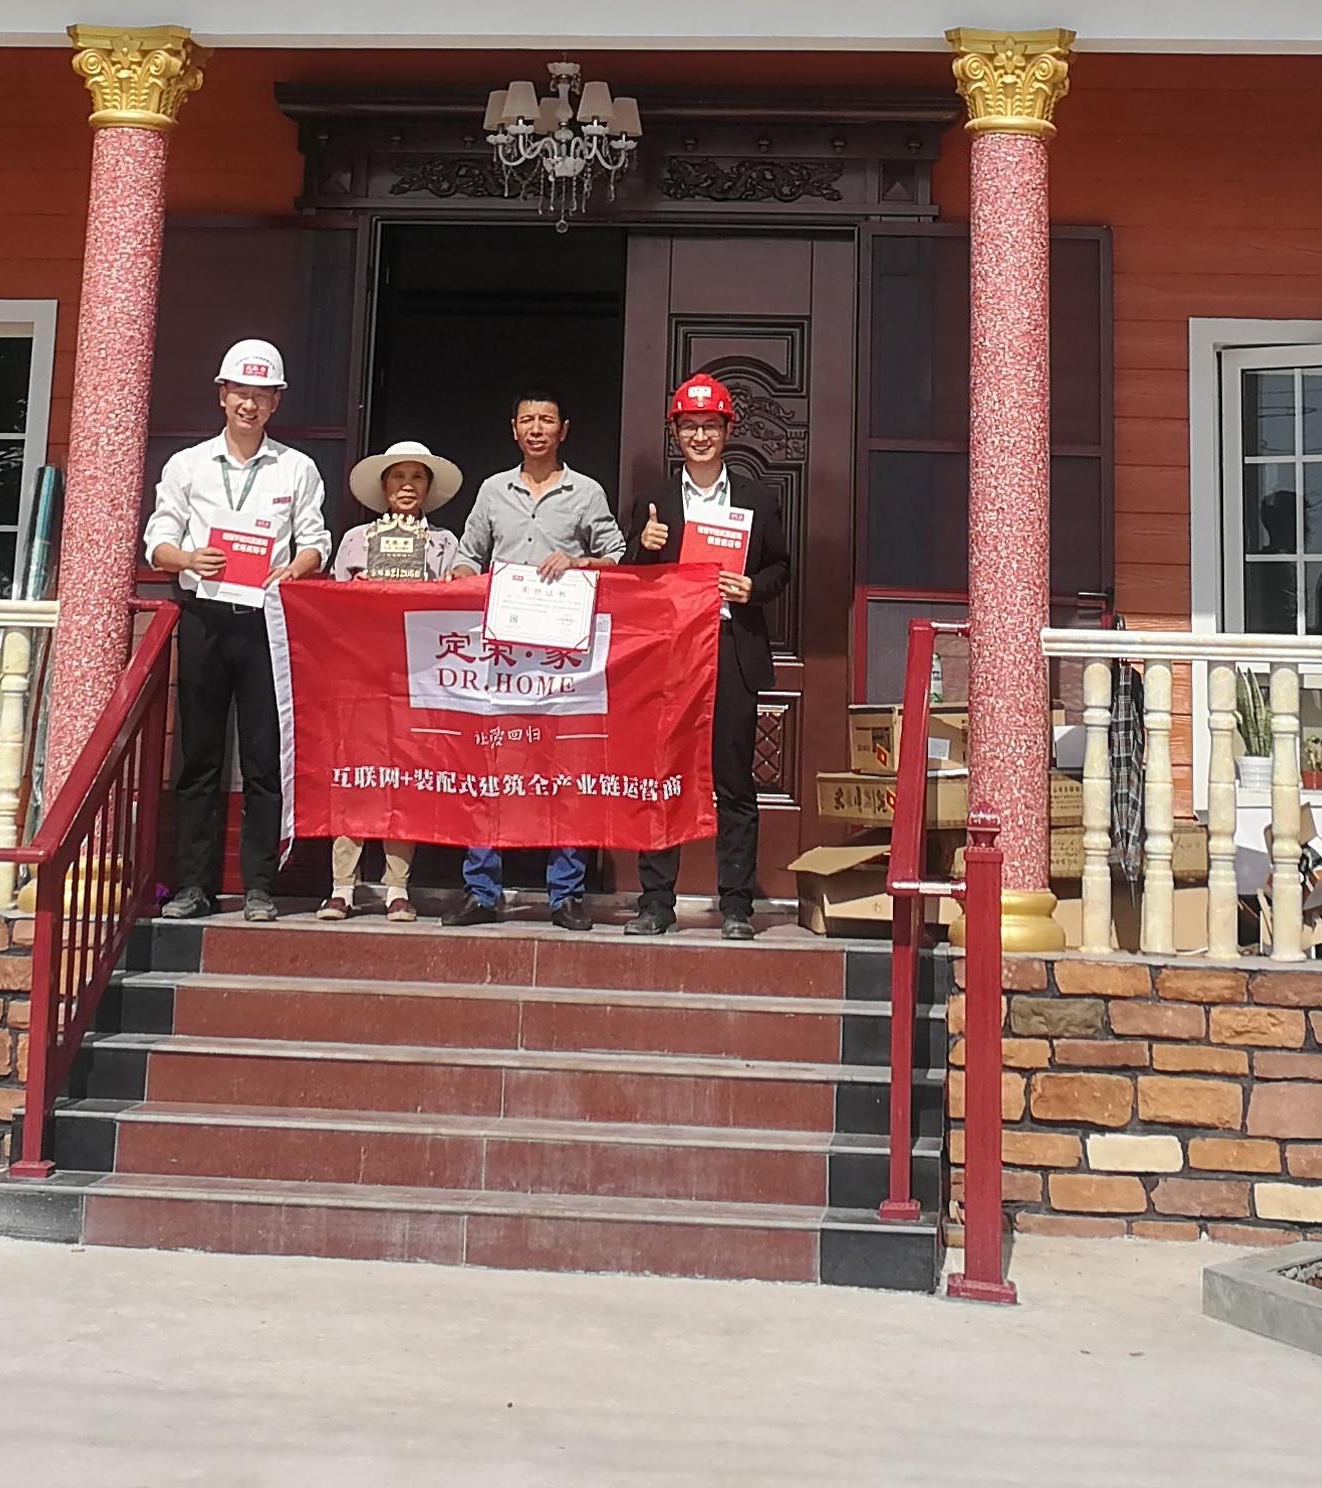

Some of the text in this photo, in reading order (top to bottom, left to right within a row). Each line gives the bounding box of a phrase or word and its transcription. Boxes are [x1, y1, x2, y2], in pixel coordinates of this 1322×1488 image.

[330, 765, 683, 802] 互联网+装配式建筑全产业链运营商
